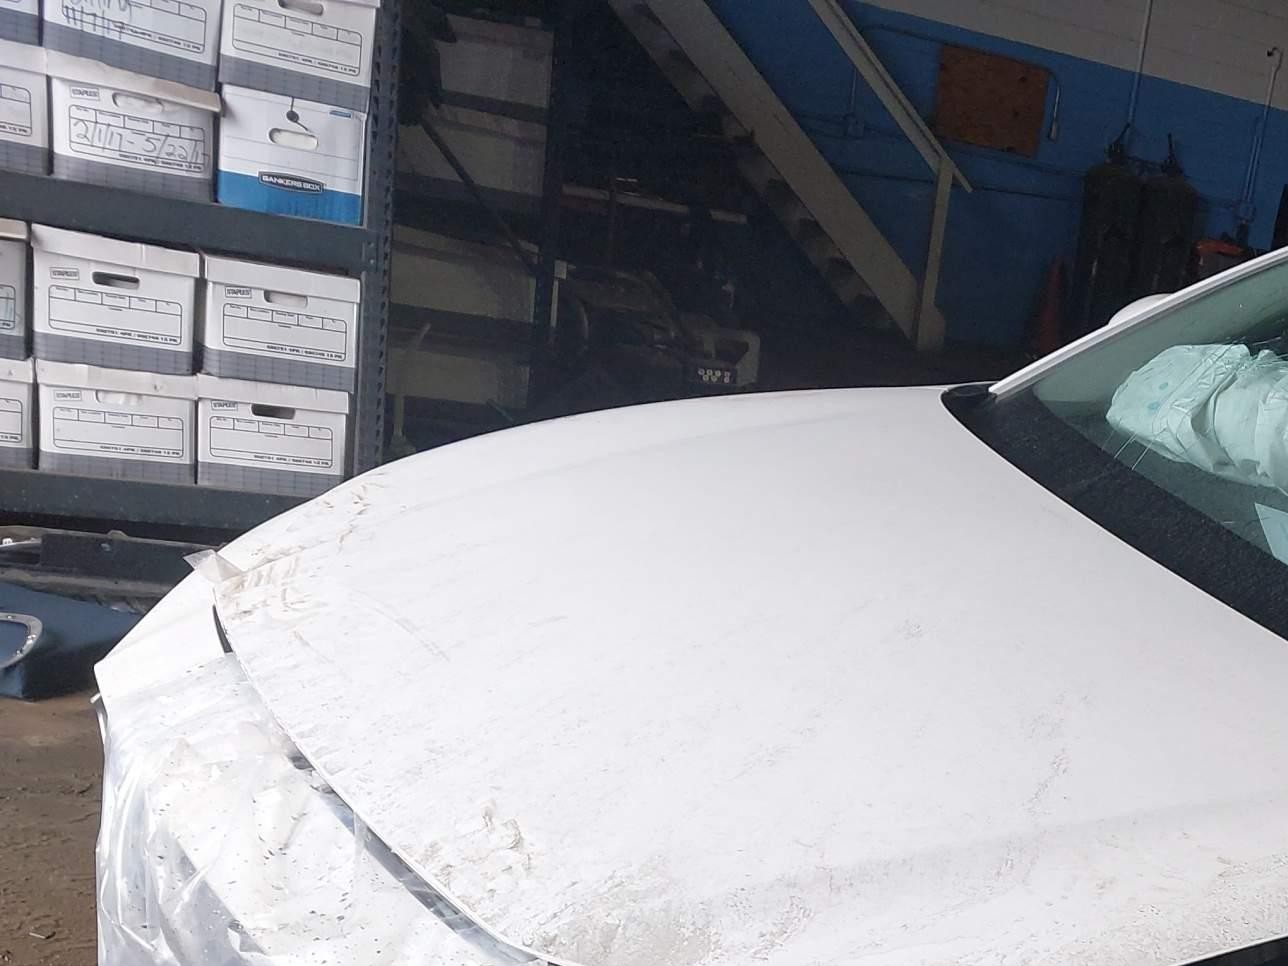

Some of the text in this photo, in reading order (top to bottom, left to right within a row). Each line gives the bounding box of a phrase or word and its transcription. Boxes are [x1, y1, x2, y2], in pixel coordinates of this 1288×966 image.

[261, 174, 321, 192] BANKERS BOX
[227, 288, 250, 297] STAPLES
[213, 401, 237, 409] STAPLES
